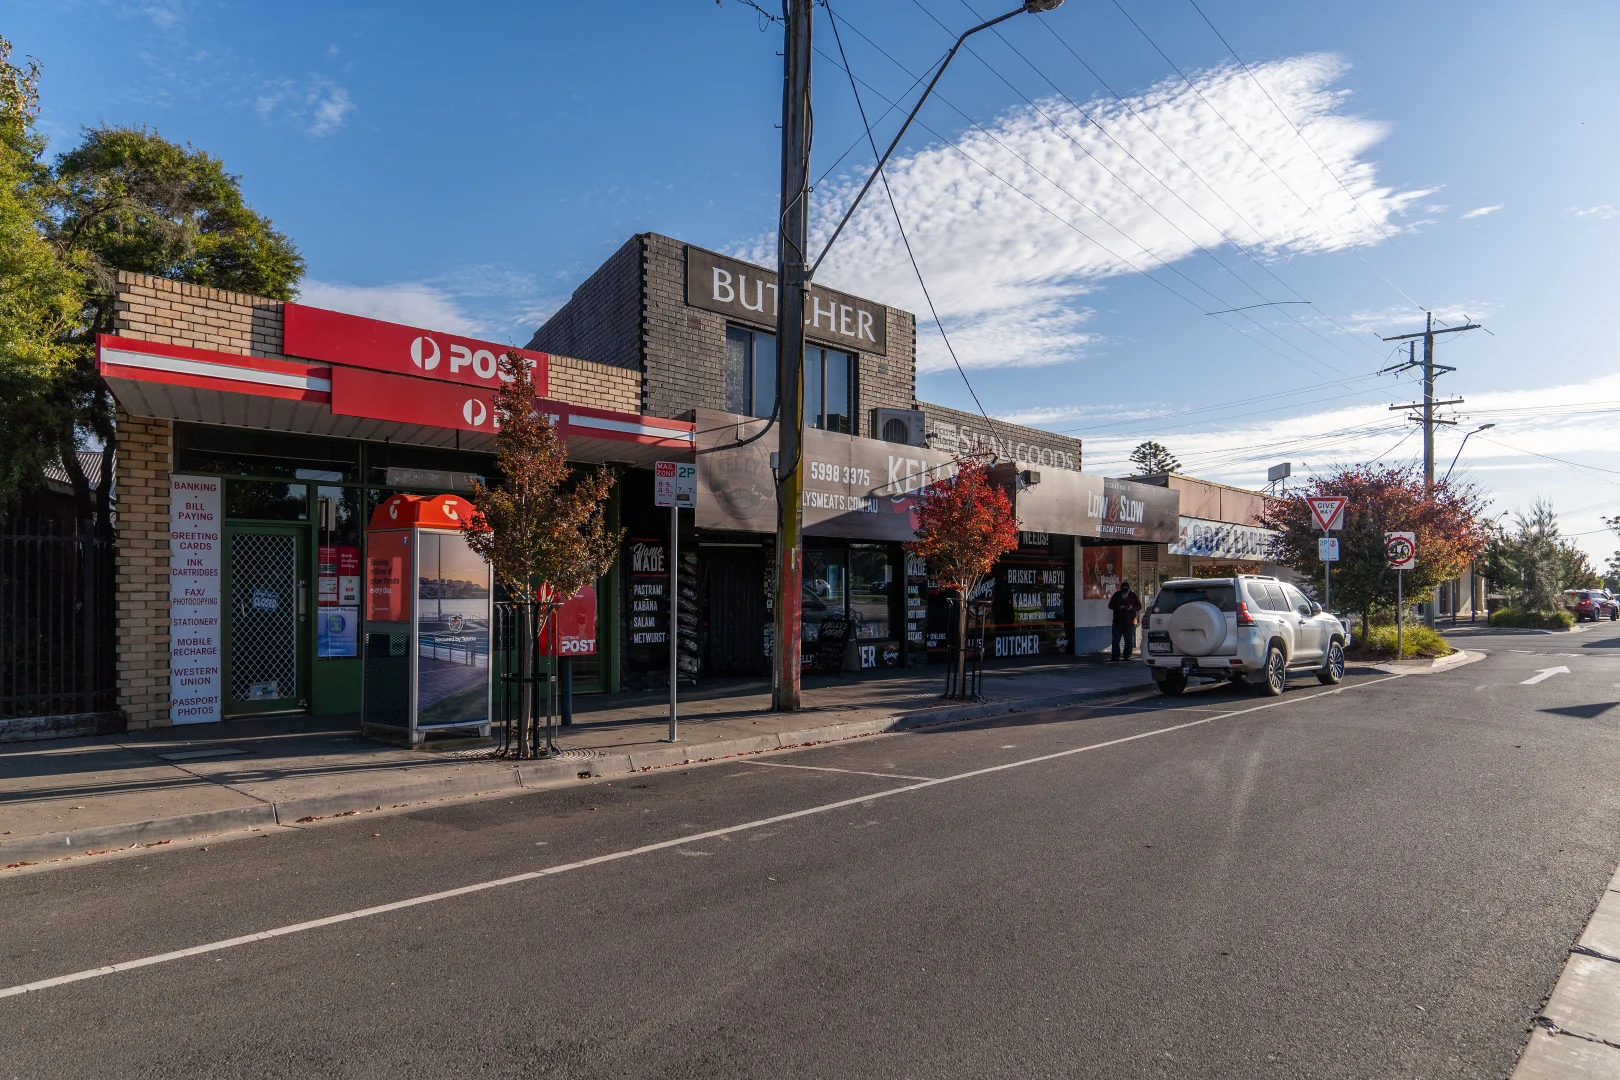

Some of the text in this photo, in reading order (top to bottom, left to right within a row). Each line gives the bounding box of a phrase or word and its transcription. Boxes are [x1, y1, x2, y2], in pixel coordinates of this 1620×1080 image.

[712, 266, 876, 343] BUTHER
[450, 344, 537, 385] POST
[678, 467, 695, 478] 2P
[811, 461, 871, 486] 5998 3375
[174, 481, 217, 492] BANKING
[185, 502, 205, 511] BILL
[178, 512, 213, 521] PAYING
[172, 531, 218, 541] GREETING
[1022, 531, 1049, 546] NEEDS!
[179, 542, 212, 550] CARDS
[633, 542, 664, 559] Home
[187, 559, 203, 567] INK
[633, 554, 665, 572] MADE
[172, 568, 219, 577] CARTRIDGES
[1007, 569, 1065, 584] BRISKET WAGYU
[185, 588, 206, 596] FAX/
[383, 586, 393, 595] day.
[633, 584, 663, 596] PASTRAMI
[172, 597, 218, 606] PHOTOCOPYING
[1012, 592, 1061, 608] KABANA RIBS
[633, 600, 658, 612] KABANA
[173, 617, 218, 627] STATIONERY
[633, 616, 655, 628] SALAMI
[177, 637, 212, 647] MOBILE
[633, 632, 666, 644] METWURST
[907, 632, 923, 641] STEAKS
[561, 639, 596, 653] POST
[995, 635, 1040, 657] BUTCHER
[173, 647, 218, 657] RECHARGE
[174, 667, 218, 677] WESTERN
[180, 677, 211, 686] UNION
[172, 695, 219, 707] PASSPORT
[177, 706, 214, 717] PHOTOS
